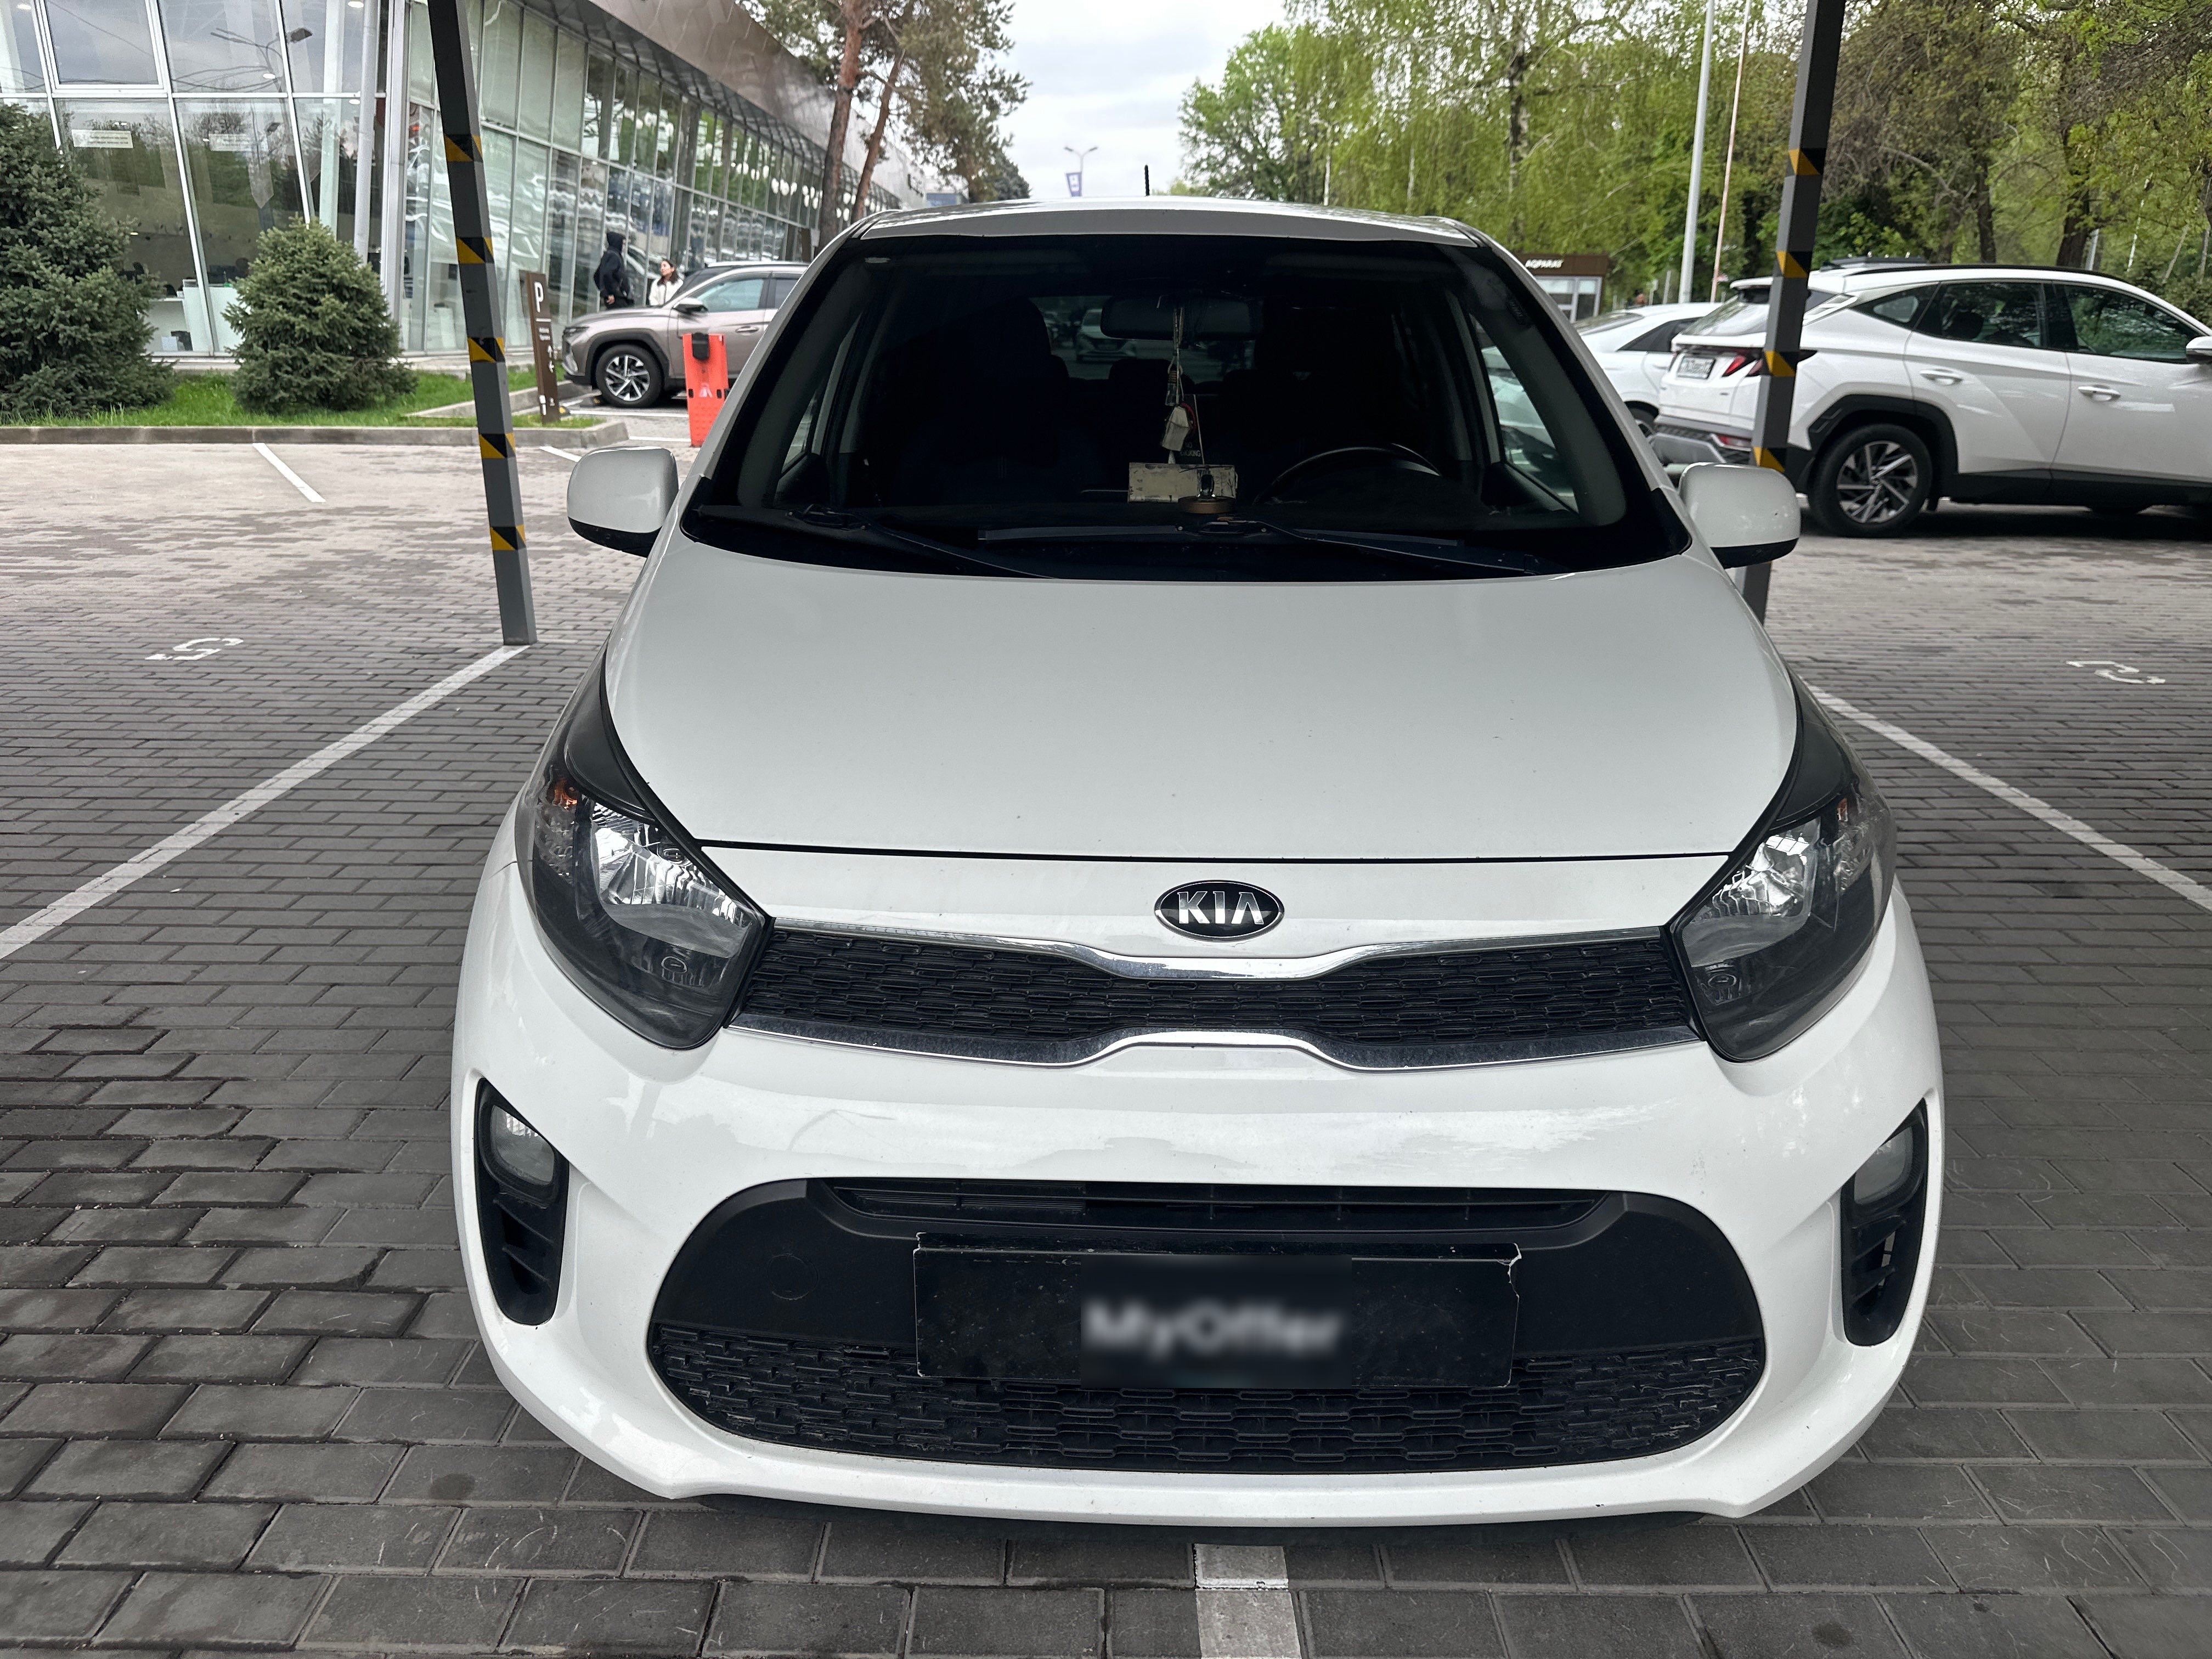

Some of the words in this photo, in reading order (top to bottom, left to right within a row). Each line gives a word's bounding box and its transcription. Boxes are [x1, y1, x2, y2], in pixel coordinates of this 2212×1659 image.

[533, 281, 544, 313] P
[1177, 890, 1265, 925] KIA
[1083, 1300, 1343, 1359] MyOffer
